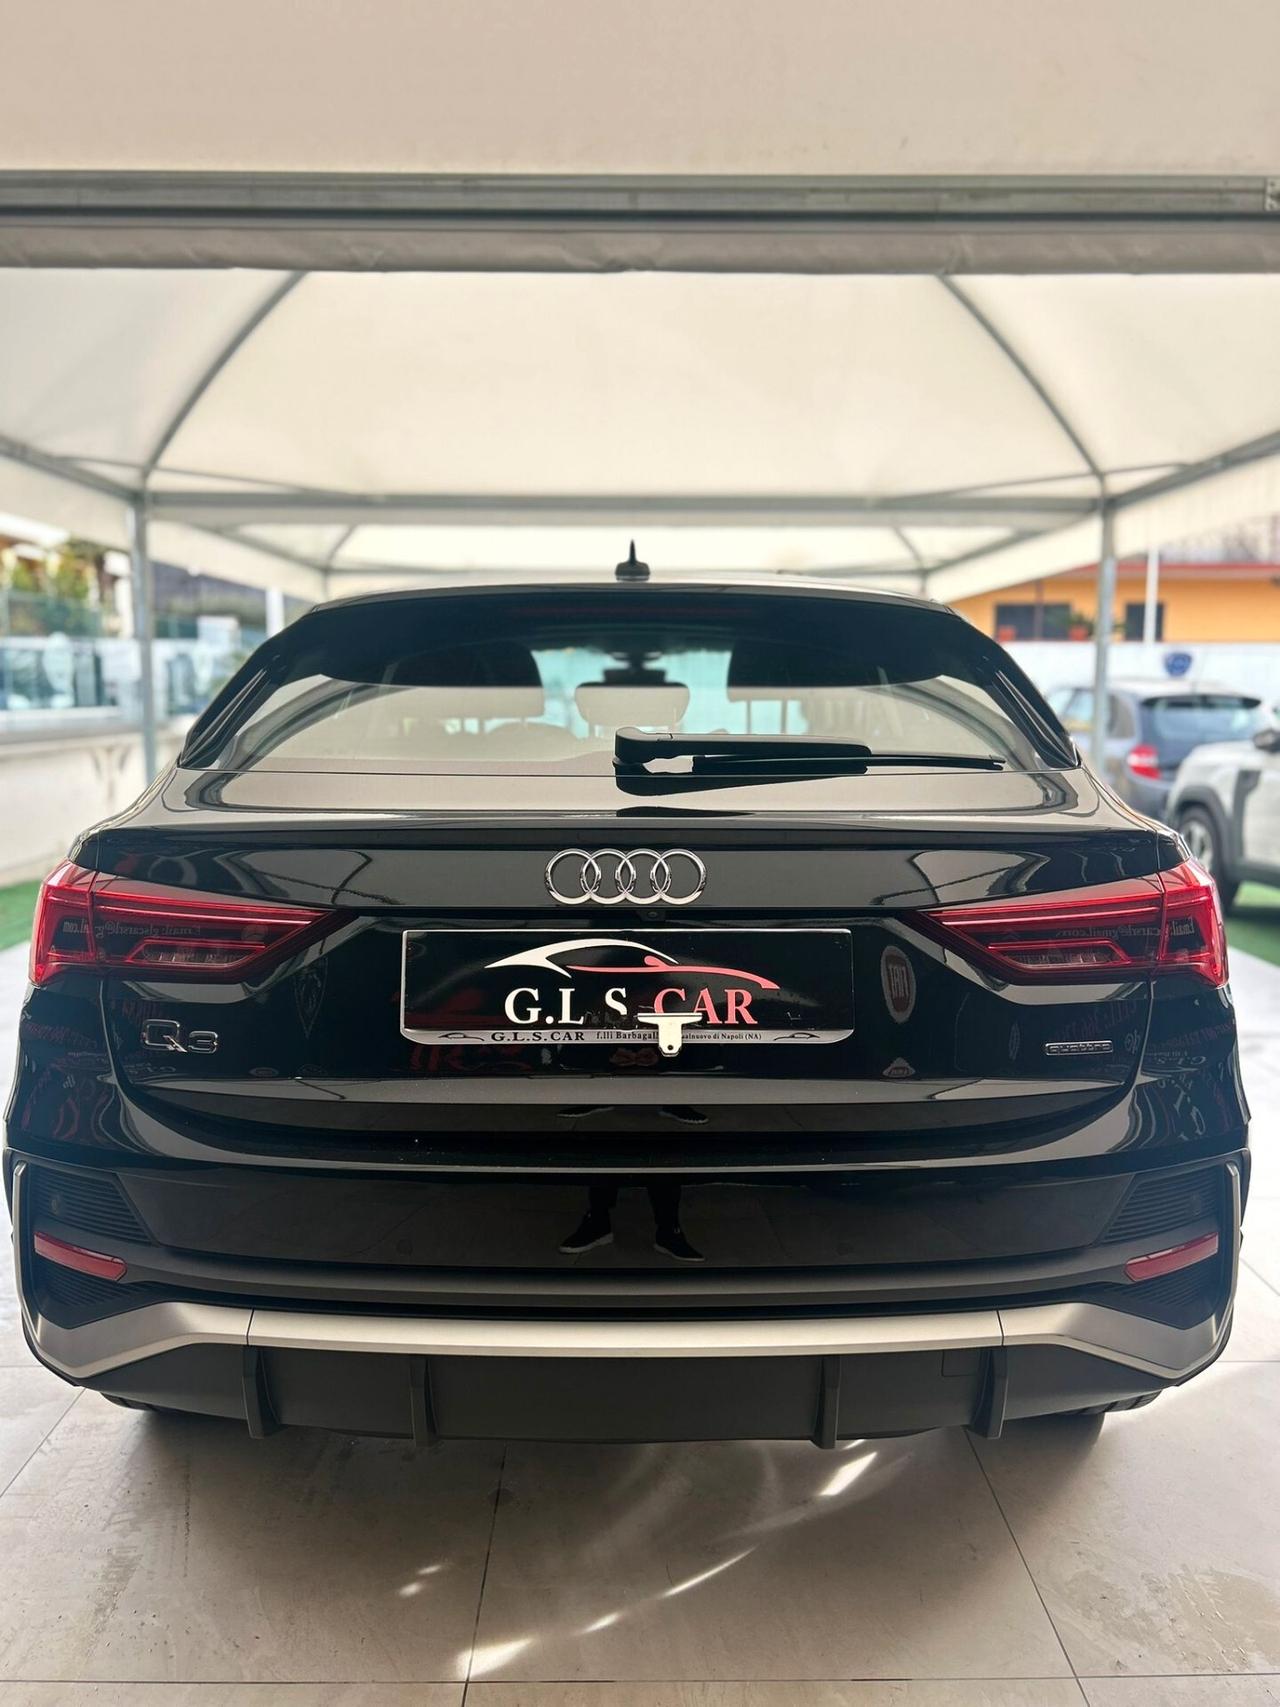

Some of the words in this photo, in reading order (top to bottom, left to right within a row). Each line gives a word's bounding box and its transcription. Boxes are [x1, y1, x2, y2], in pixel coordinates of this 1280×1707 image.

[653, 987, 758, 1025] CAR
[142, 1018, 219, 1054] Q3
[491, 1031, 585, 1042] G.L.S.CAR
[616, 1031, 660, 1041] Barbagall
[713, 1032, 720, 1040] di
[721, 1032, 744, 1041] Napoli
[745, 1032, 762, 1041] (NA)
[1047, 1042, 1112, 1054] quattro
